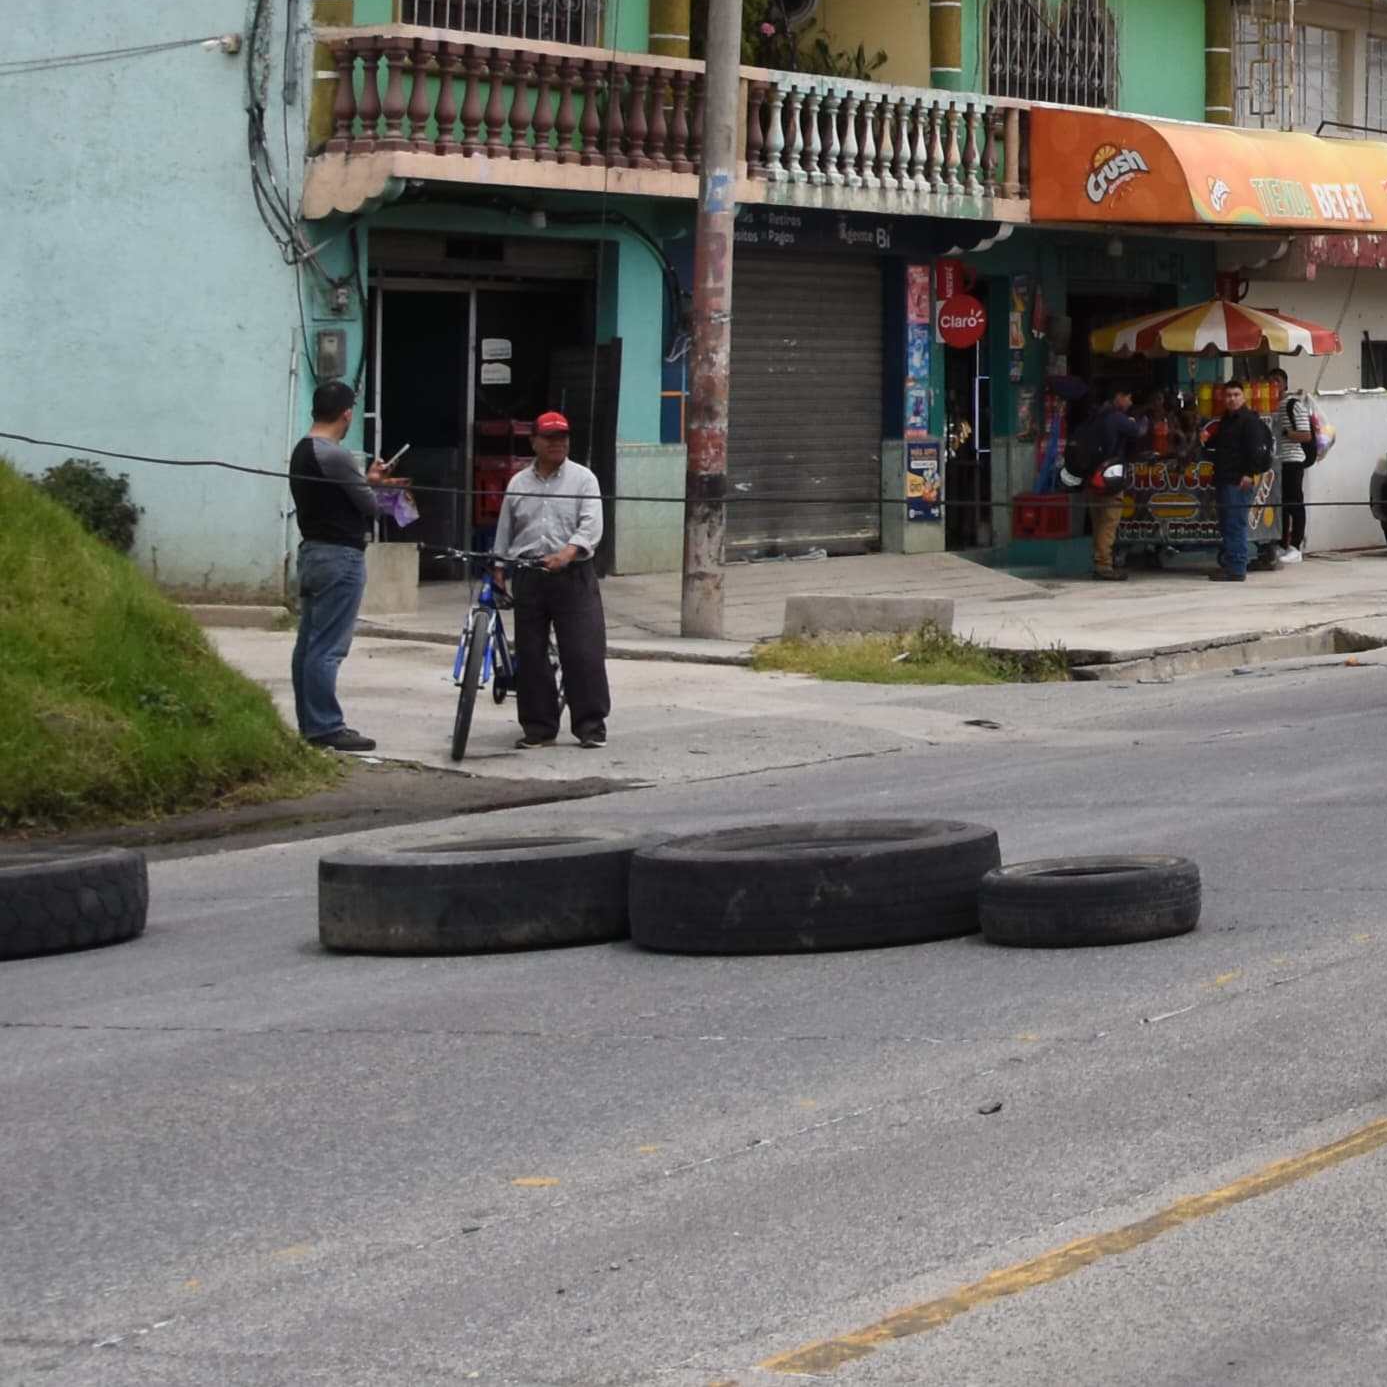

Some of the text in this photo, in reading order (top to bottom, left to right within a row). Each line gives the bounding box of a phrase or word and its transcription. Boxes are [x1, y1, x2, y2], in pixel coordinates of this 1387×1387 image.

[1086, 148, 1149, 204] Crush
[1249, 177, 1315, 219] TIENDA
[940, 313, 979, 328] Claro
